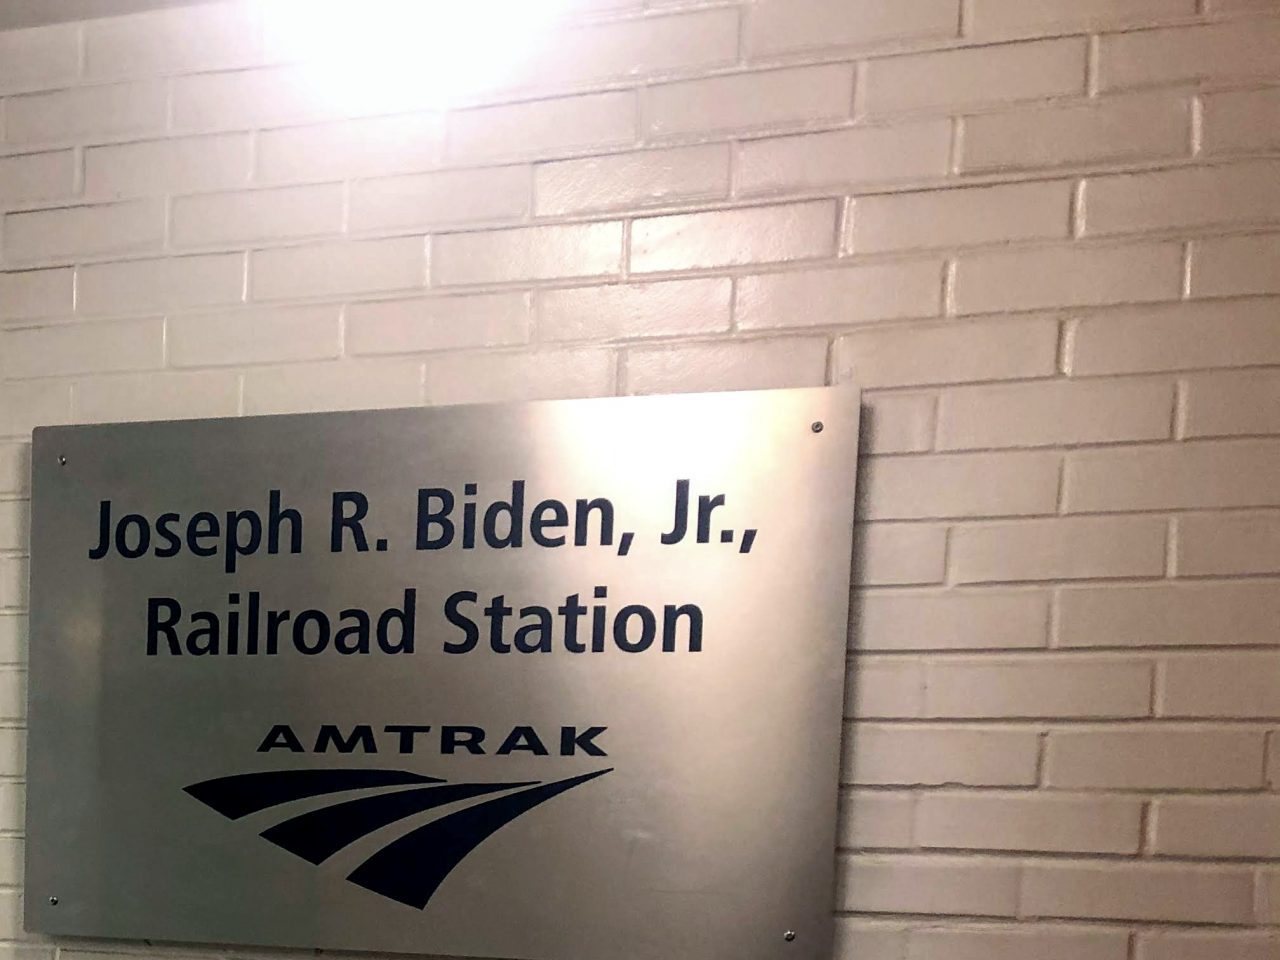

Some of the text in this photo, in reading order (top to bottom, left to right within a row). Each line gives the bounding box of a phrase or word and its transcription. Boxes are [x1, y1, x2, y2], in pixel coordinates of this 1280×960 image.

[88, 479, 758, 573] Joseph R. Biden, Jr.,
[146, 586, 704, 657] Railroad Station
[257, 725, 609, 758] AMTRAK
